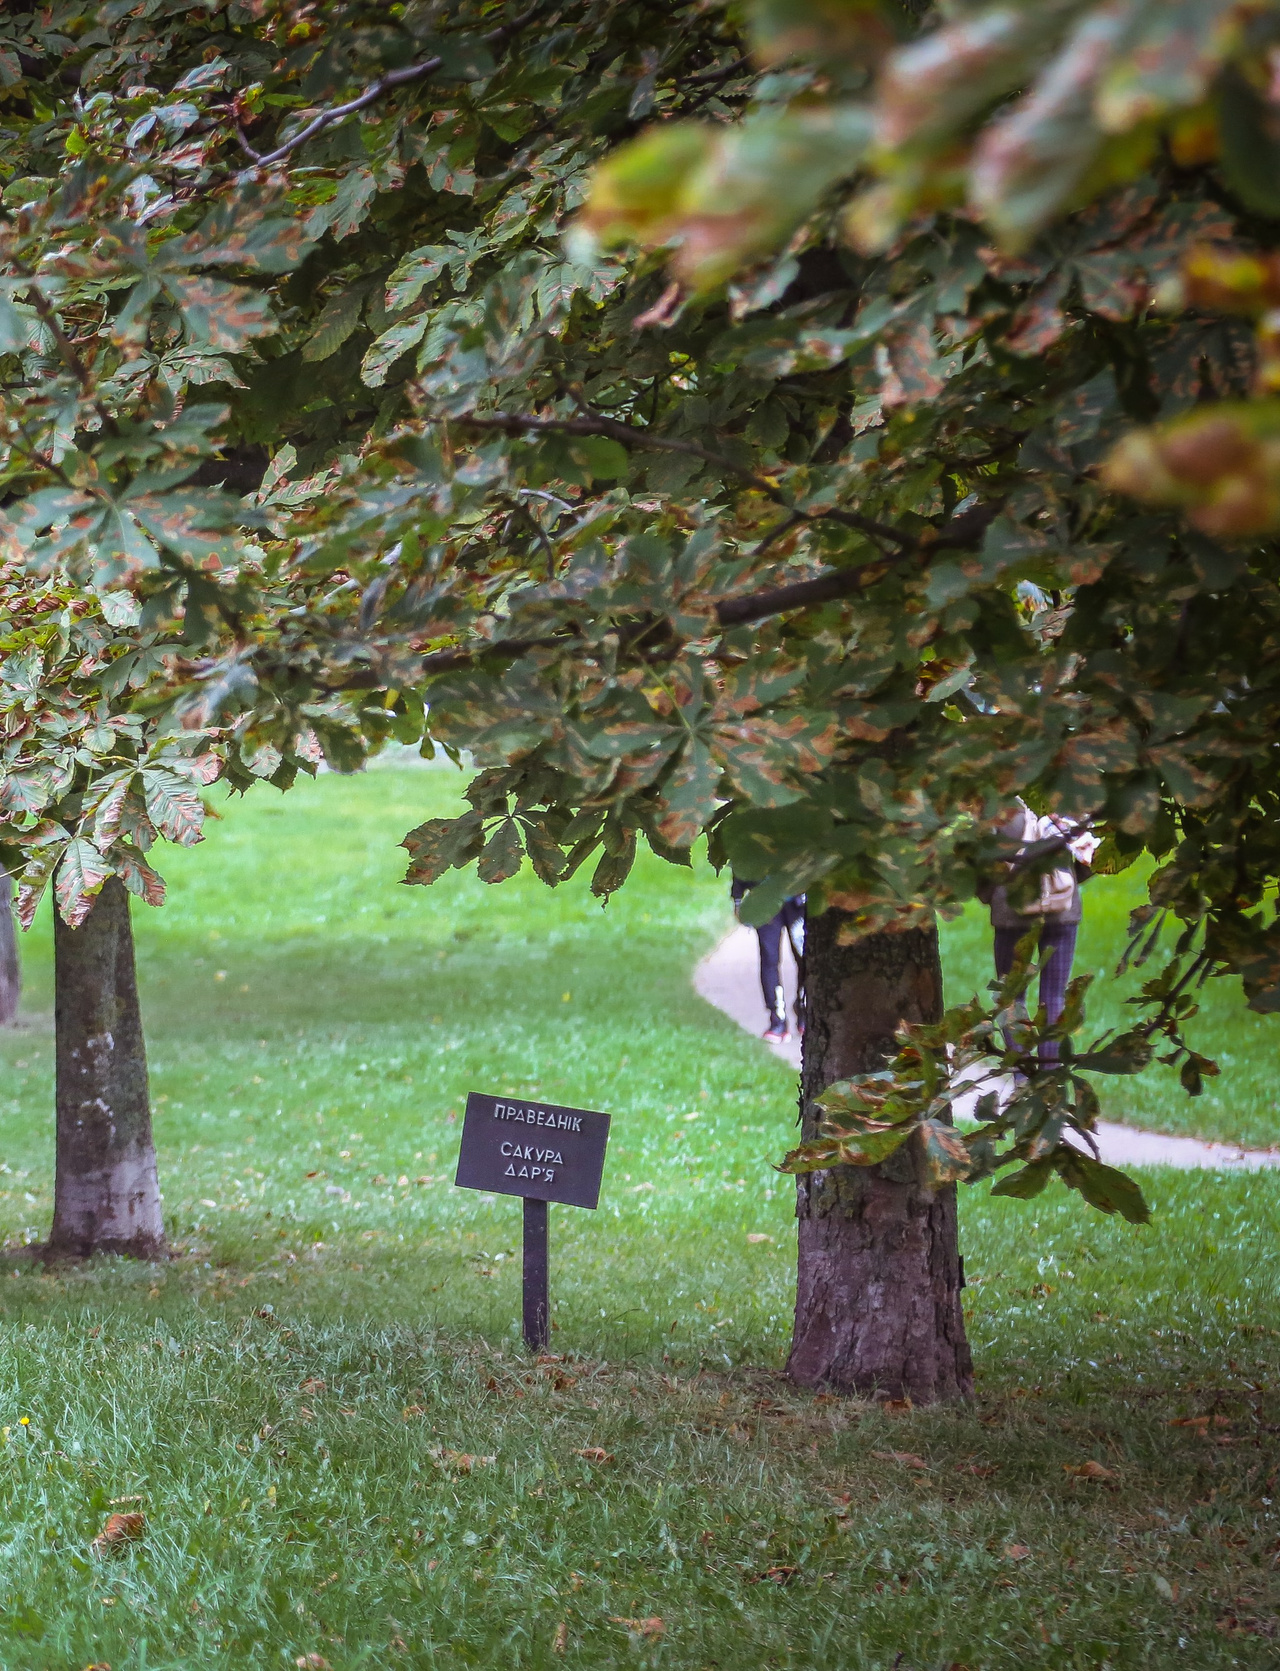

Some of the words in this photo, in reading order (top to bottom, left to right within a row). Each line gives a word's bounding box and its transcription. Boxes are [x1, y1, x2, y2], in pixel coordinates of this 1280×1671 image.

[494, 1103, 583, 1132] ПРАВЕДНІК
[500, 1141, 564, 1165] САКУРА
[504, 1163, 555, 1182] ДАР'Я
